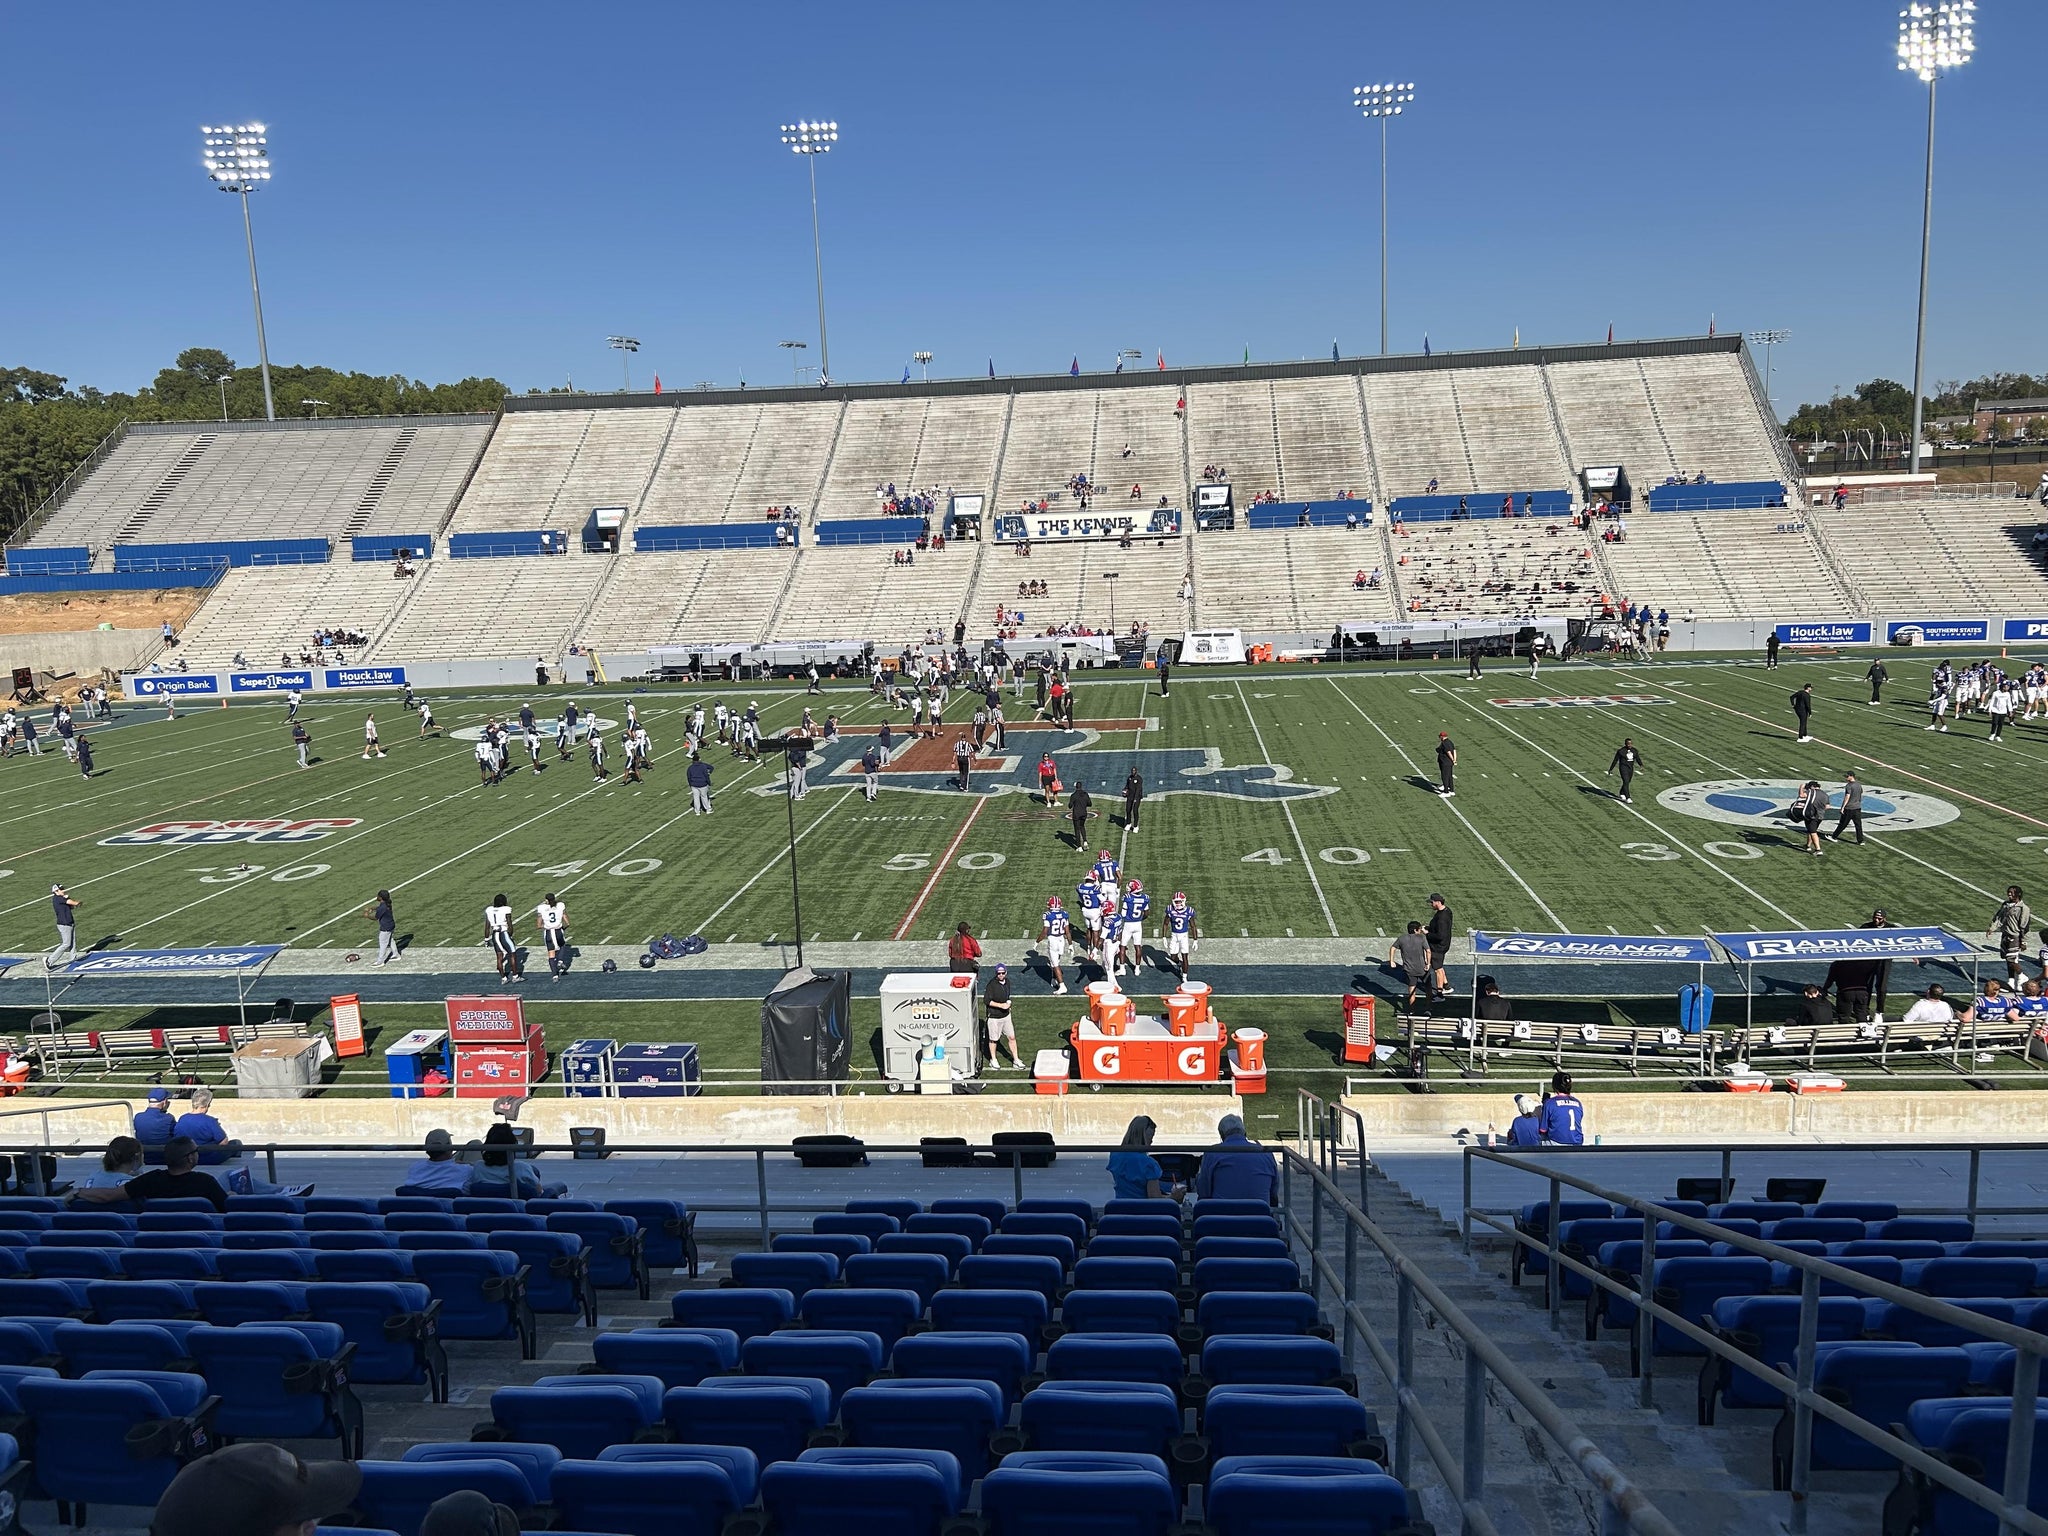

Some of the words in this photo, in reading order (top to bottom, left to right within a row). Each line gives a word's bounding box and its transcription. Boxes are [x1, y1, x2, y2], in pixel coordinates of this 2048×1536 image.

[1038, 520, 1069, 531] THE
[1790, 626, 1854, 637] Houck.law
[17, 670, 32, 684] 25
[340, 670, 393, 680] Houck.law
[157, 681, 186, 691] Origin
[188, 681, 211, 689] Bank
[1669, 778, 1771, 803] ORIGIN
[97, 818, 364, 846] SBC
[1103, 866, 1115, 881] 11
[1083, 894, 1092, 907] 6
[549, 912, 557, 924] 3
[1132, 904, 1143, 919] 5
[493, 913, 497, 925] 1
[1174, 917, 1185, 930] 3
[1489, 938, 1692, 953] RADIANCE
[1747, 936, 1942, 957] RADIANCE
[1796, 944, 1945, 954] TECHNOLOGIES
[460, 1010, 507, 1020] SPORTS
[911, 1006, 941, 1020] SBC
[456, 1021, 514, 1031] MEDICINE
[1093, 1046, 1120, 1075] G
[1178, 1046, 1206, 1075] G
[1569, 1109, 1576, 1130] 1
